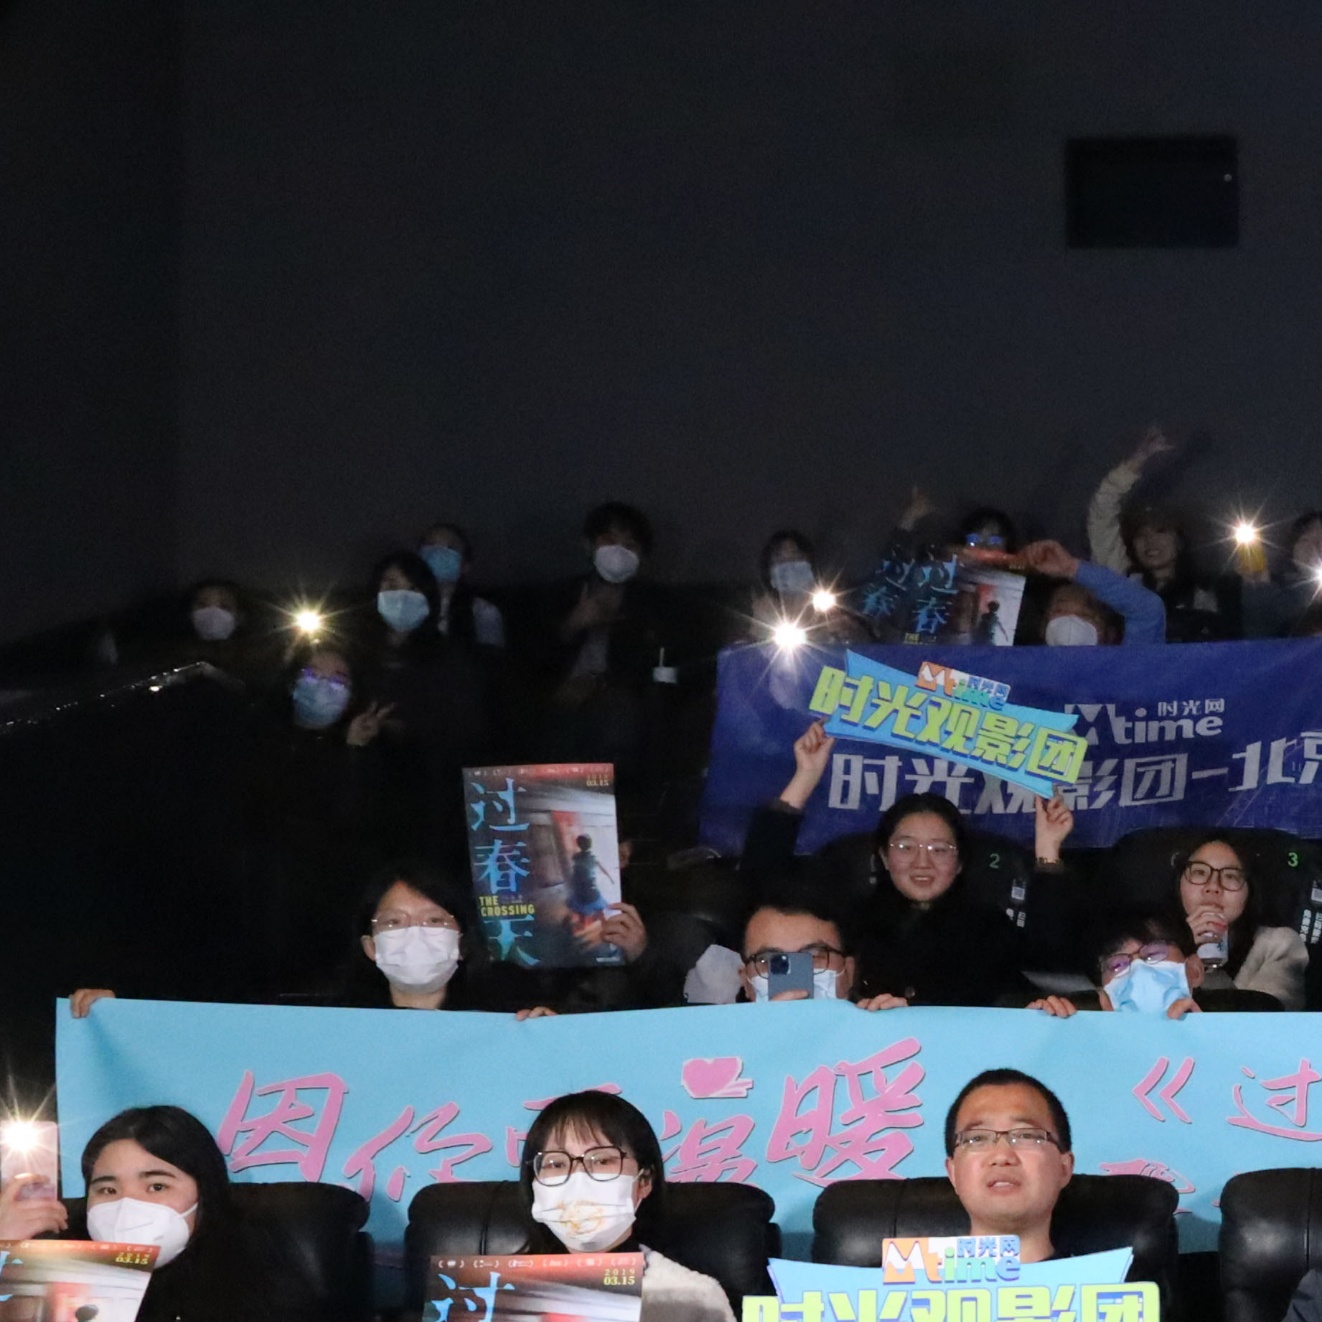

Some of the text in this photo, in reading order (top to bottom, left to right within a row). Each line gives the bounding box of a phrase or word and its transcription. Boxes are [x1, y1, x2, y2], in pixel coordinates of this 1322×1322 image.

[1157, 697, 1226, 718] 时光网
[808, 665, 1089, 786] 时光观影团
[988, 852, 1002, 869] 2
[1286, 851, 1300, 868] 3
[468, 777, 541, 966] 过春天
[479, 895, 499, 907] THE
[480, 903, 536, 918] CROSSING
[216, 1036, 926, 1203] 因你温暖
[956, 1236, 1021, 1259] 时光网
[882, 1239, 1021, 1285] Mtime
[603, 1275, 637, 1287] 03.15
[604, 1268, 637, 1277] 2019
